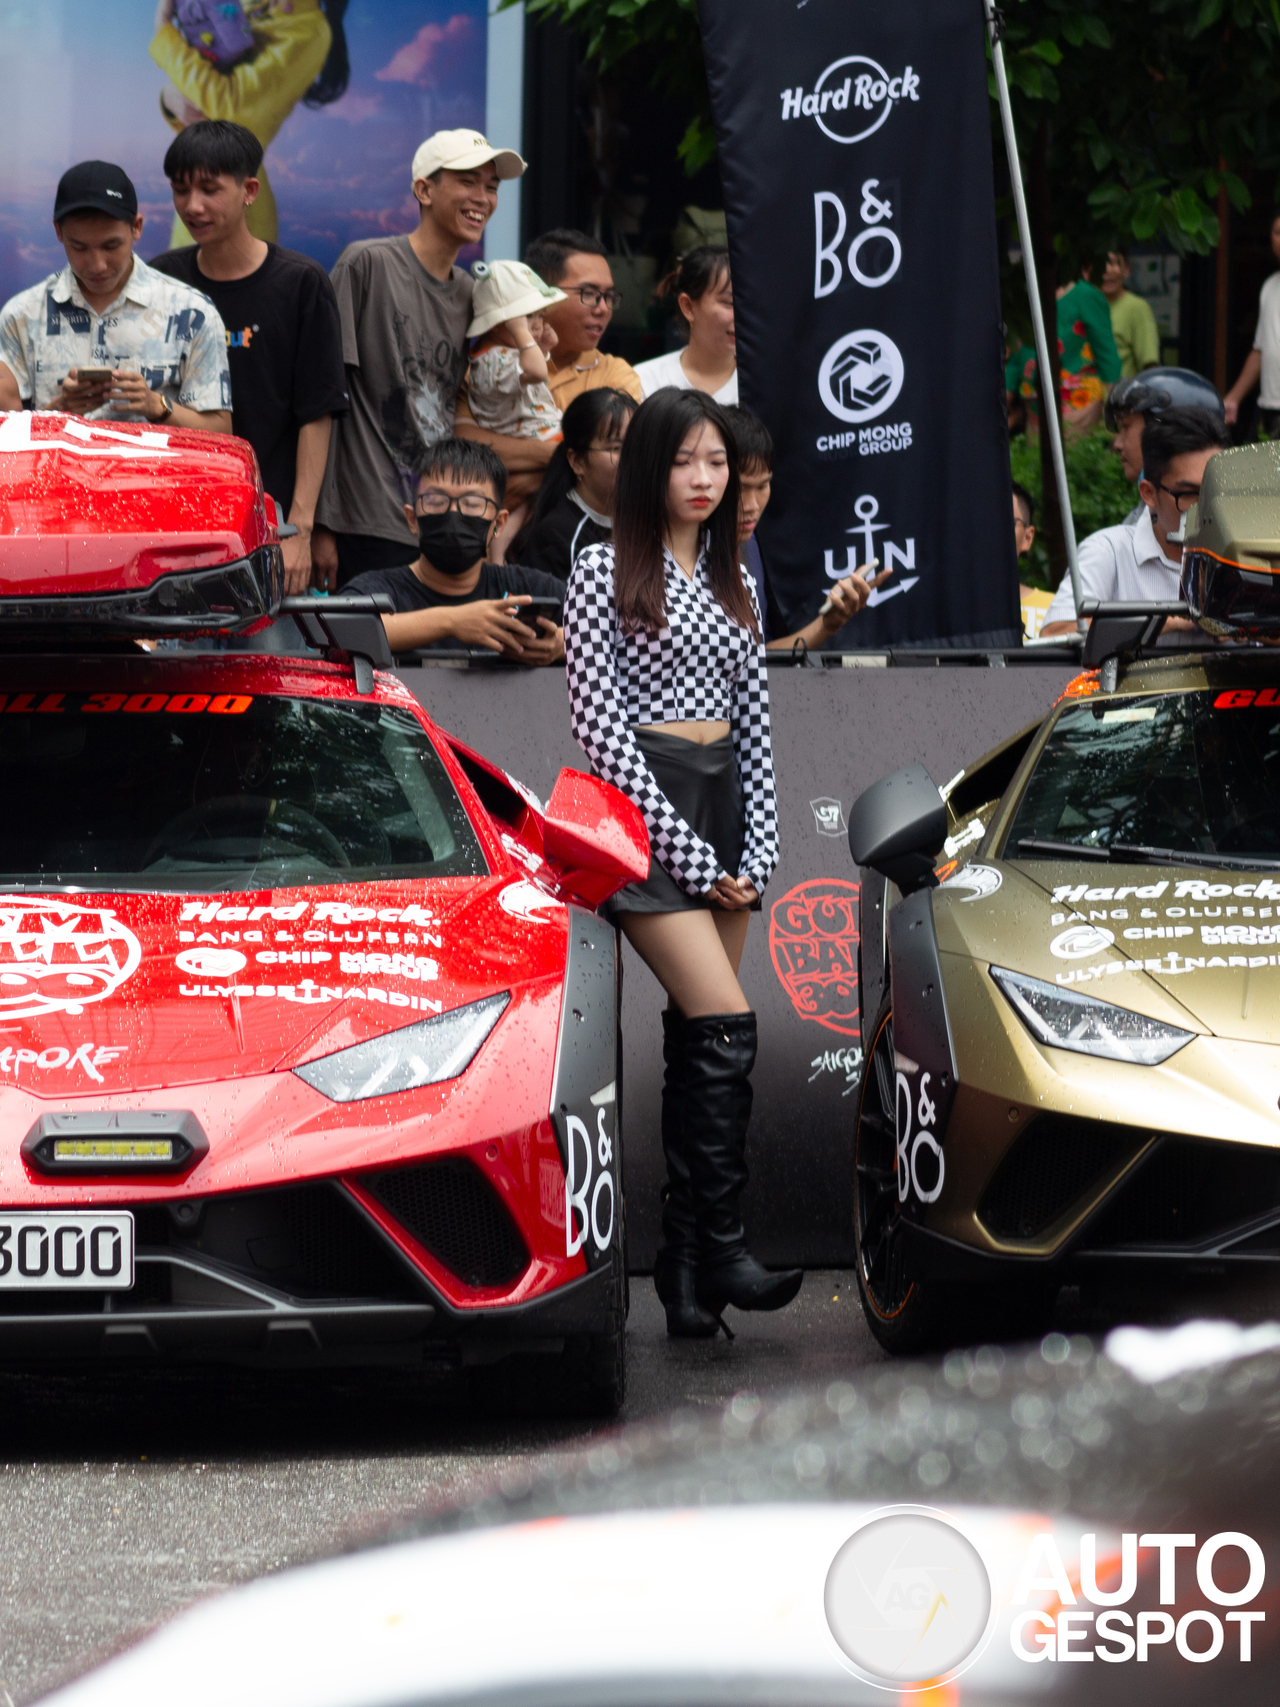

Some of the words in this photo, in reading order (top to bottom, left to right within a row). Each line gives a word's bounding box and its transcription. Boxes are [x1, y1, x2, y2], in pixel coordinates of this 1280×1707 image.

[780, 77, 852, 121] Hard
[854, 65, 920, 111] Rock
[816, 431, 856, 452] CHIP
[858, 422, 913, 444] MONG
[858, 437, 913, 456] GROUP
[79, 693, 253, 714] 3000
[1051, 880, 1170, 903] Hard
[179, 901, 309, 922] Hard
[312, 902, 434, 927] Rock
[1051, 908, 1129, 926] BANG
[1140, 908, 1158, 918] &
[1165, 905, 1280, 919] OLUFSE
[179, 930, 263, 944] BANG
[275, 930, 294, 942] &
[302, 930, 442, 948] OLUFSEN
[1123, 926, 1194, 939] CHIP
[1202, 935, 1280, 945] GROU
[255, 951, 332, 964] CHIP
[339, 951, 439, 970] MONG
[1055, 958, 1162, 985] ULYSSE
[1185, 955, 1280, 968] NARDI
[340, 962, 439, 981] GROUP
[179, 984, 297, 998] ULYSSE
[320, 986, 443, 1012] NARDIN
